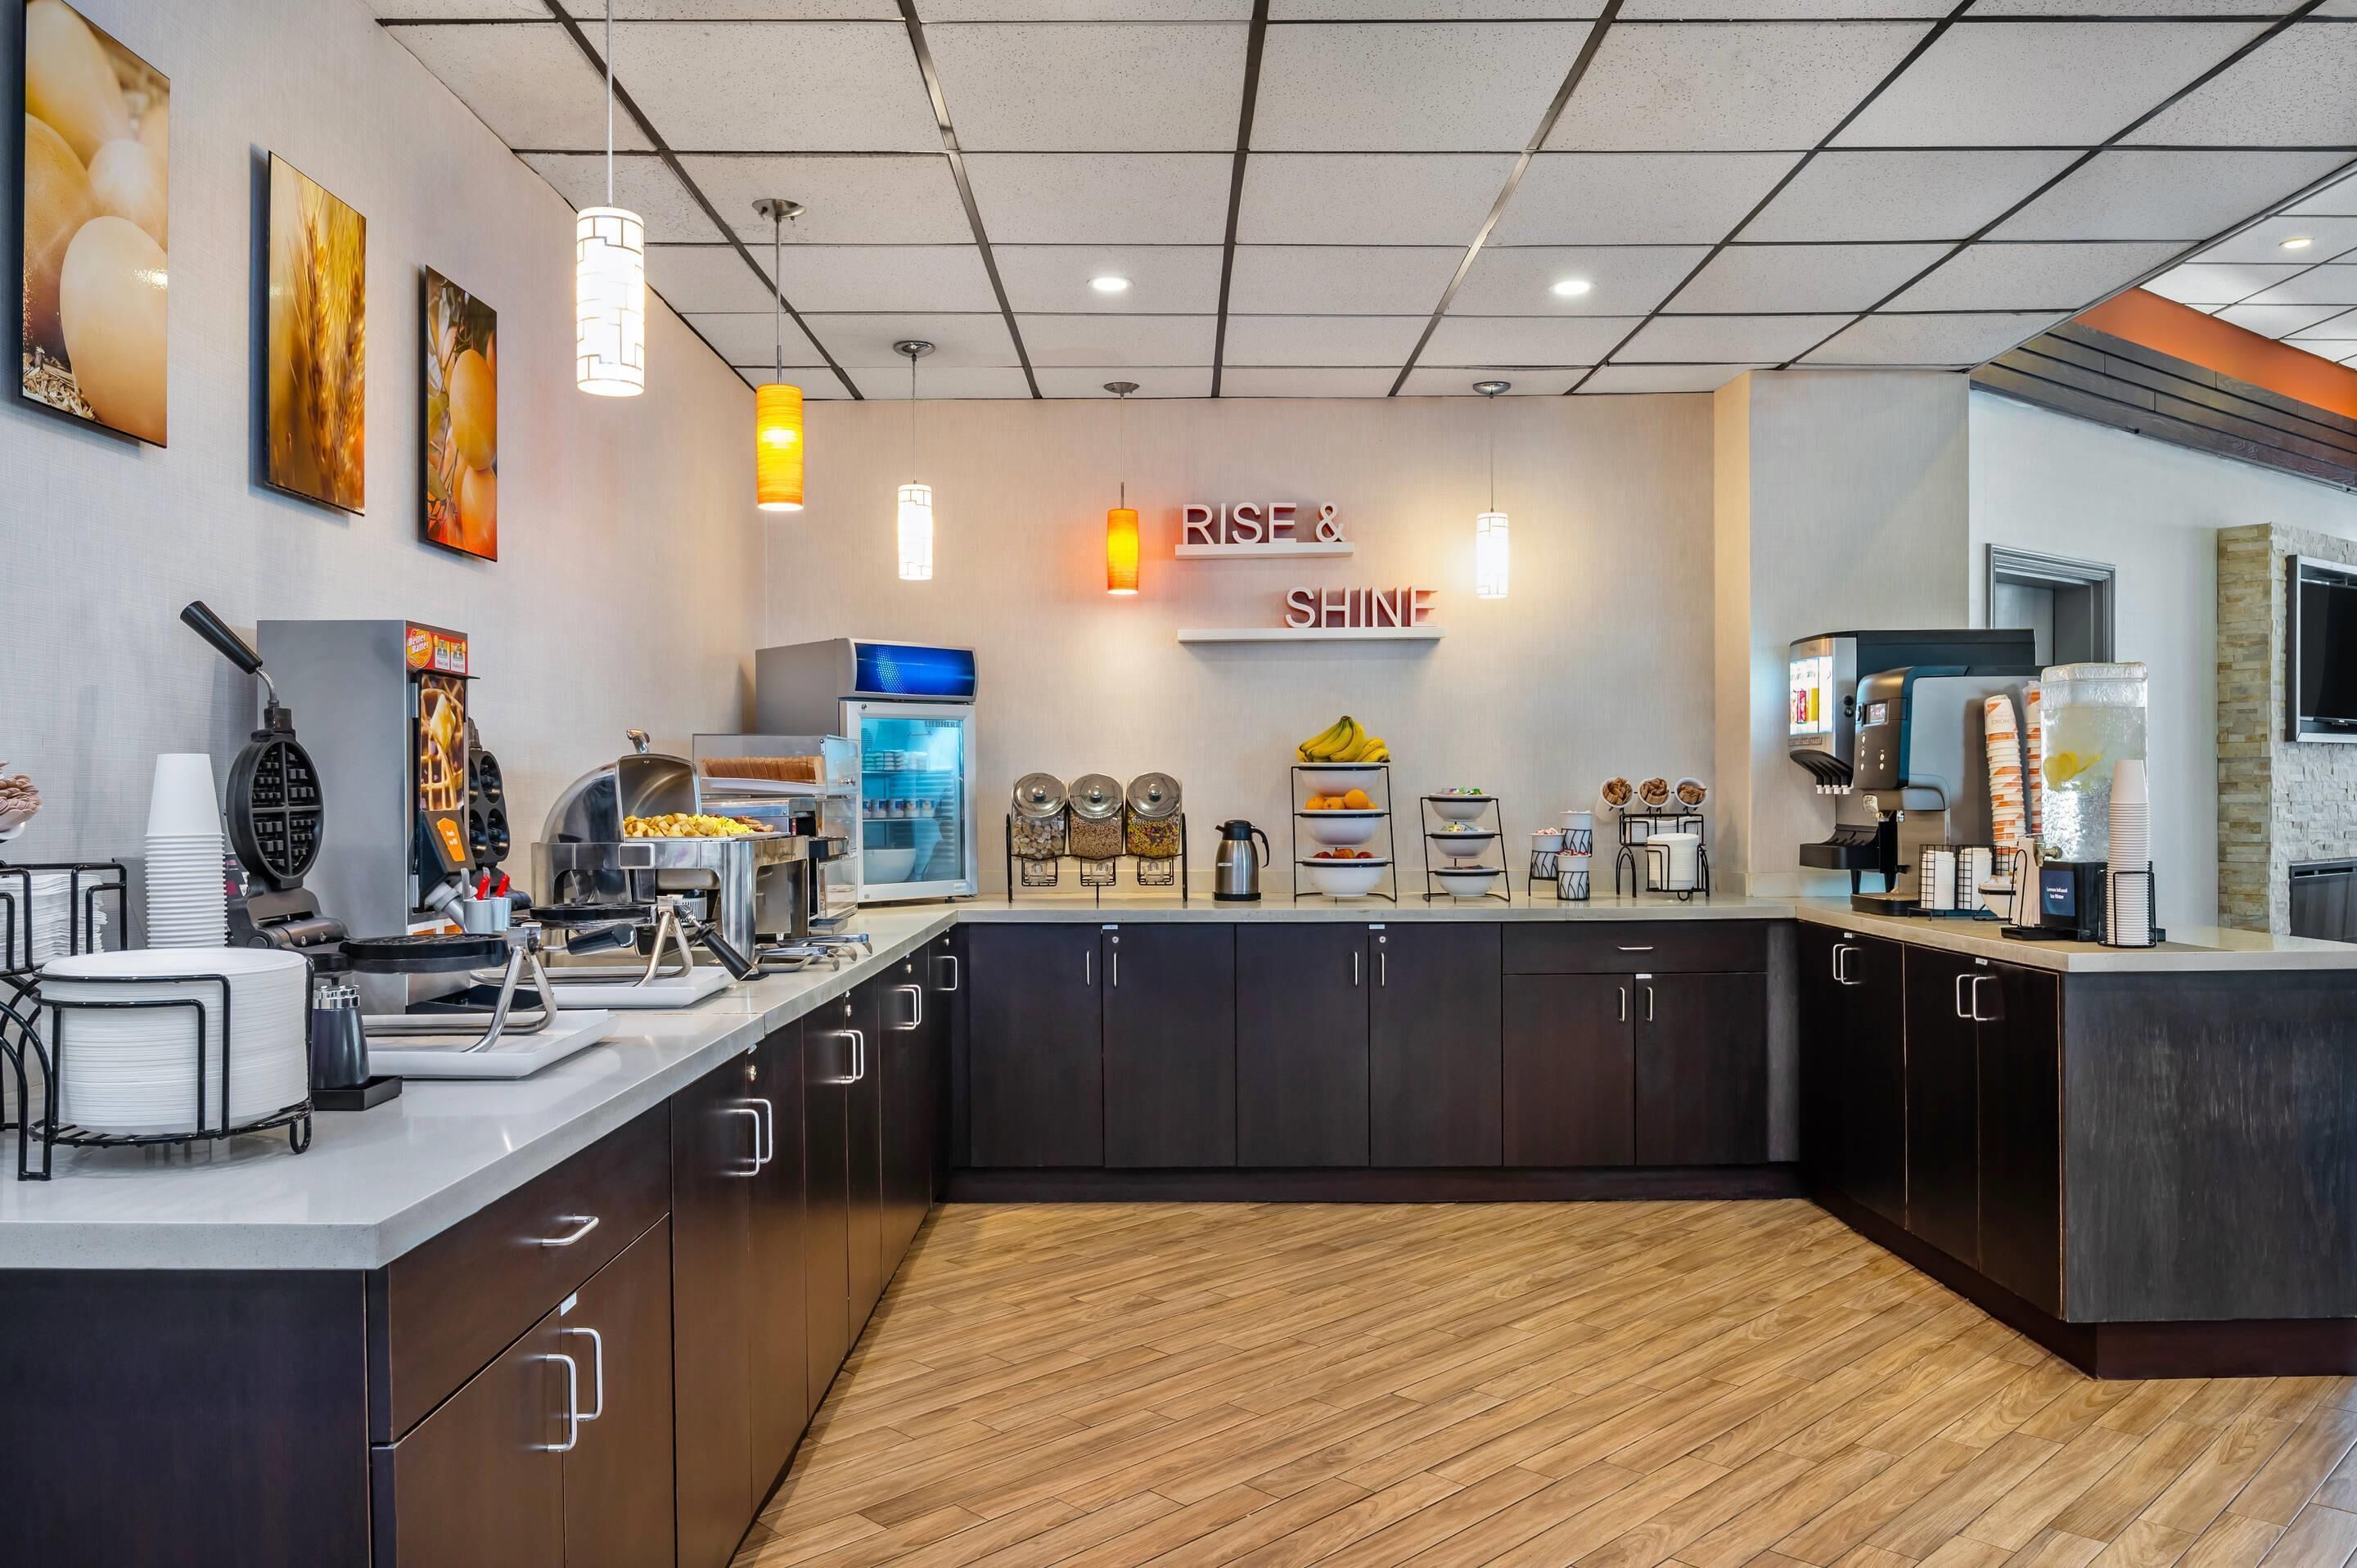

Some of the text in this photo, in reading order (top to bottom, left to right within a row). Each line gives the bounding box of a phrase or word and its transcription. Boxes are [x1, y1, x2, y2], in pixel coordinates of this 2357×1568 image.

[1183, 502, 1346, 544] RISE &
[1285, 586, 1440, 629] SHINE
[407, 634, 426, 646] Better
[412, 641, 429, 653] Batter
